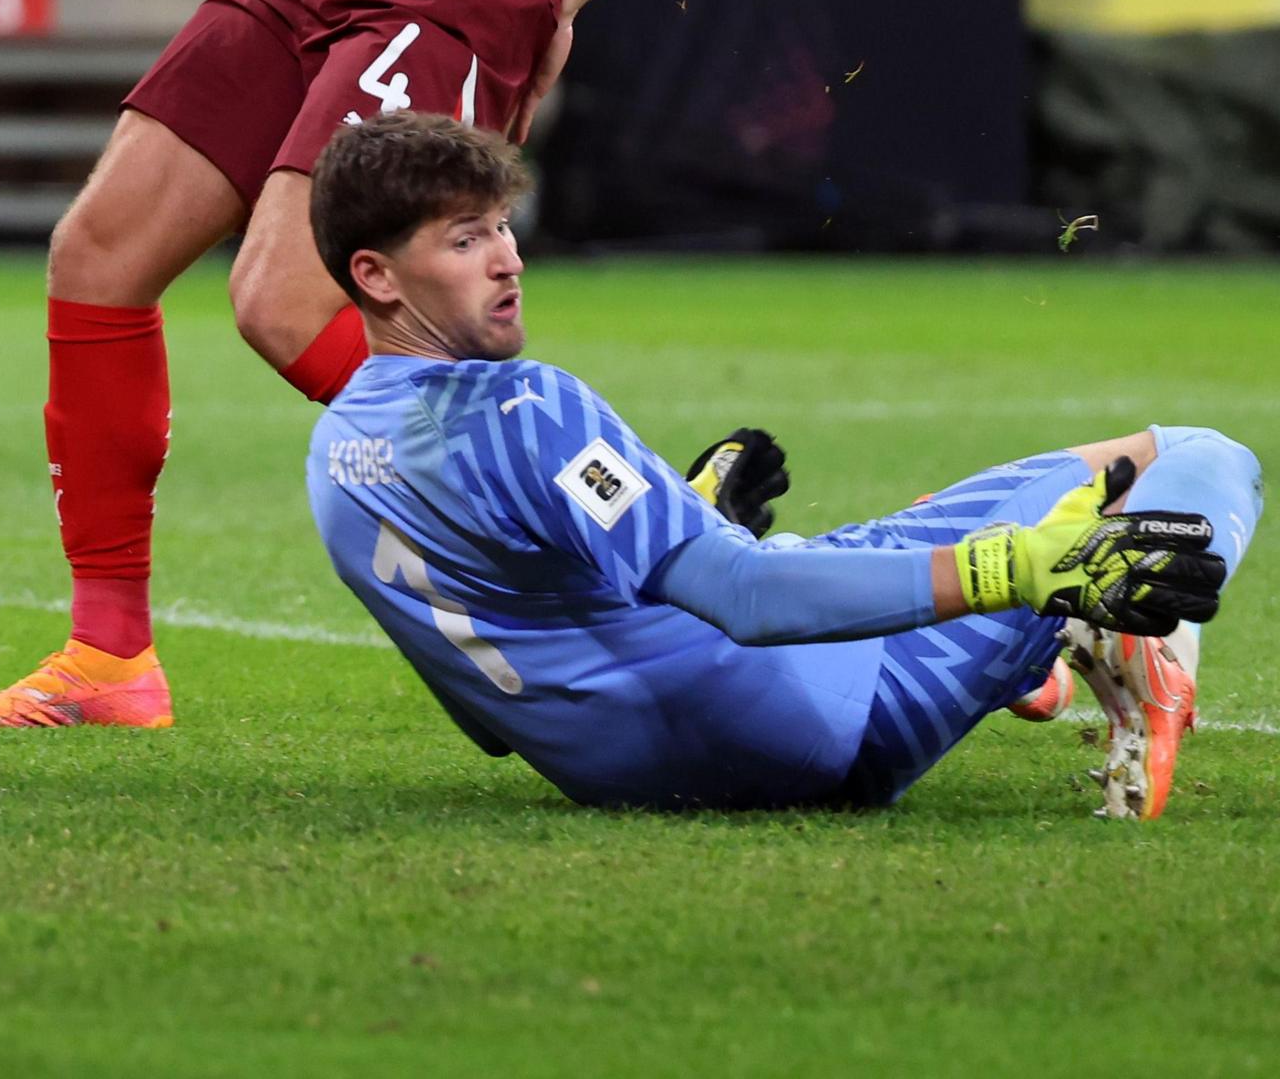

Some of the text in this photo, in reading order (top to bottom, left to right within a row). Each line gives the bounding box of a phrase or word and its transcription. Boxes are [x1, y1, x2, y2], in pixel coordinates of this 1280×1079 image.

[359, 22, 421, 116] 4
[1139, 520, 1213, 537] reusch
[372, 517, 524, 695] 1
